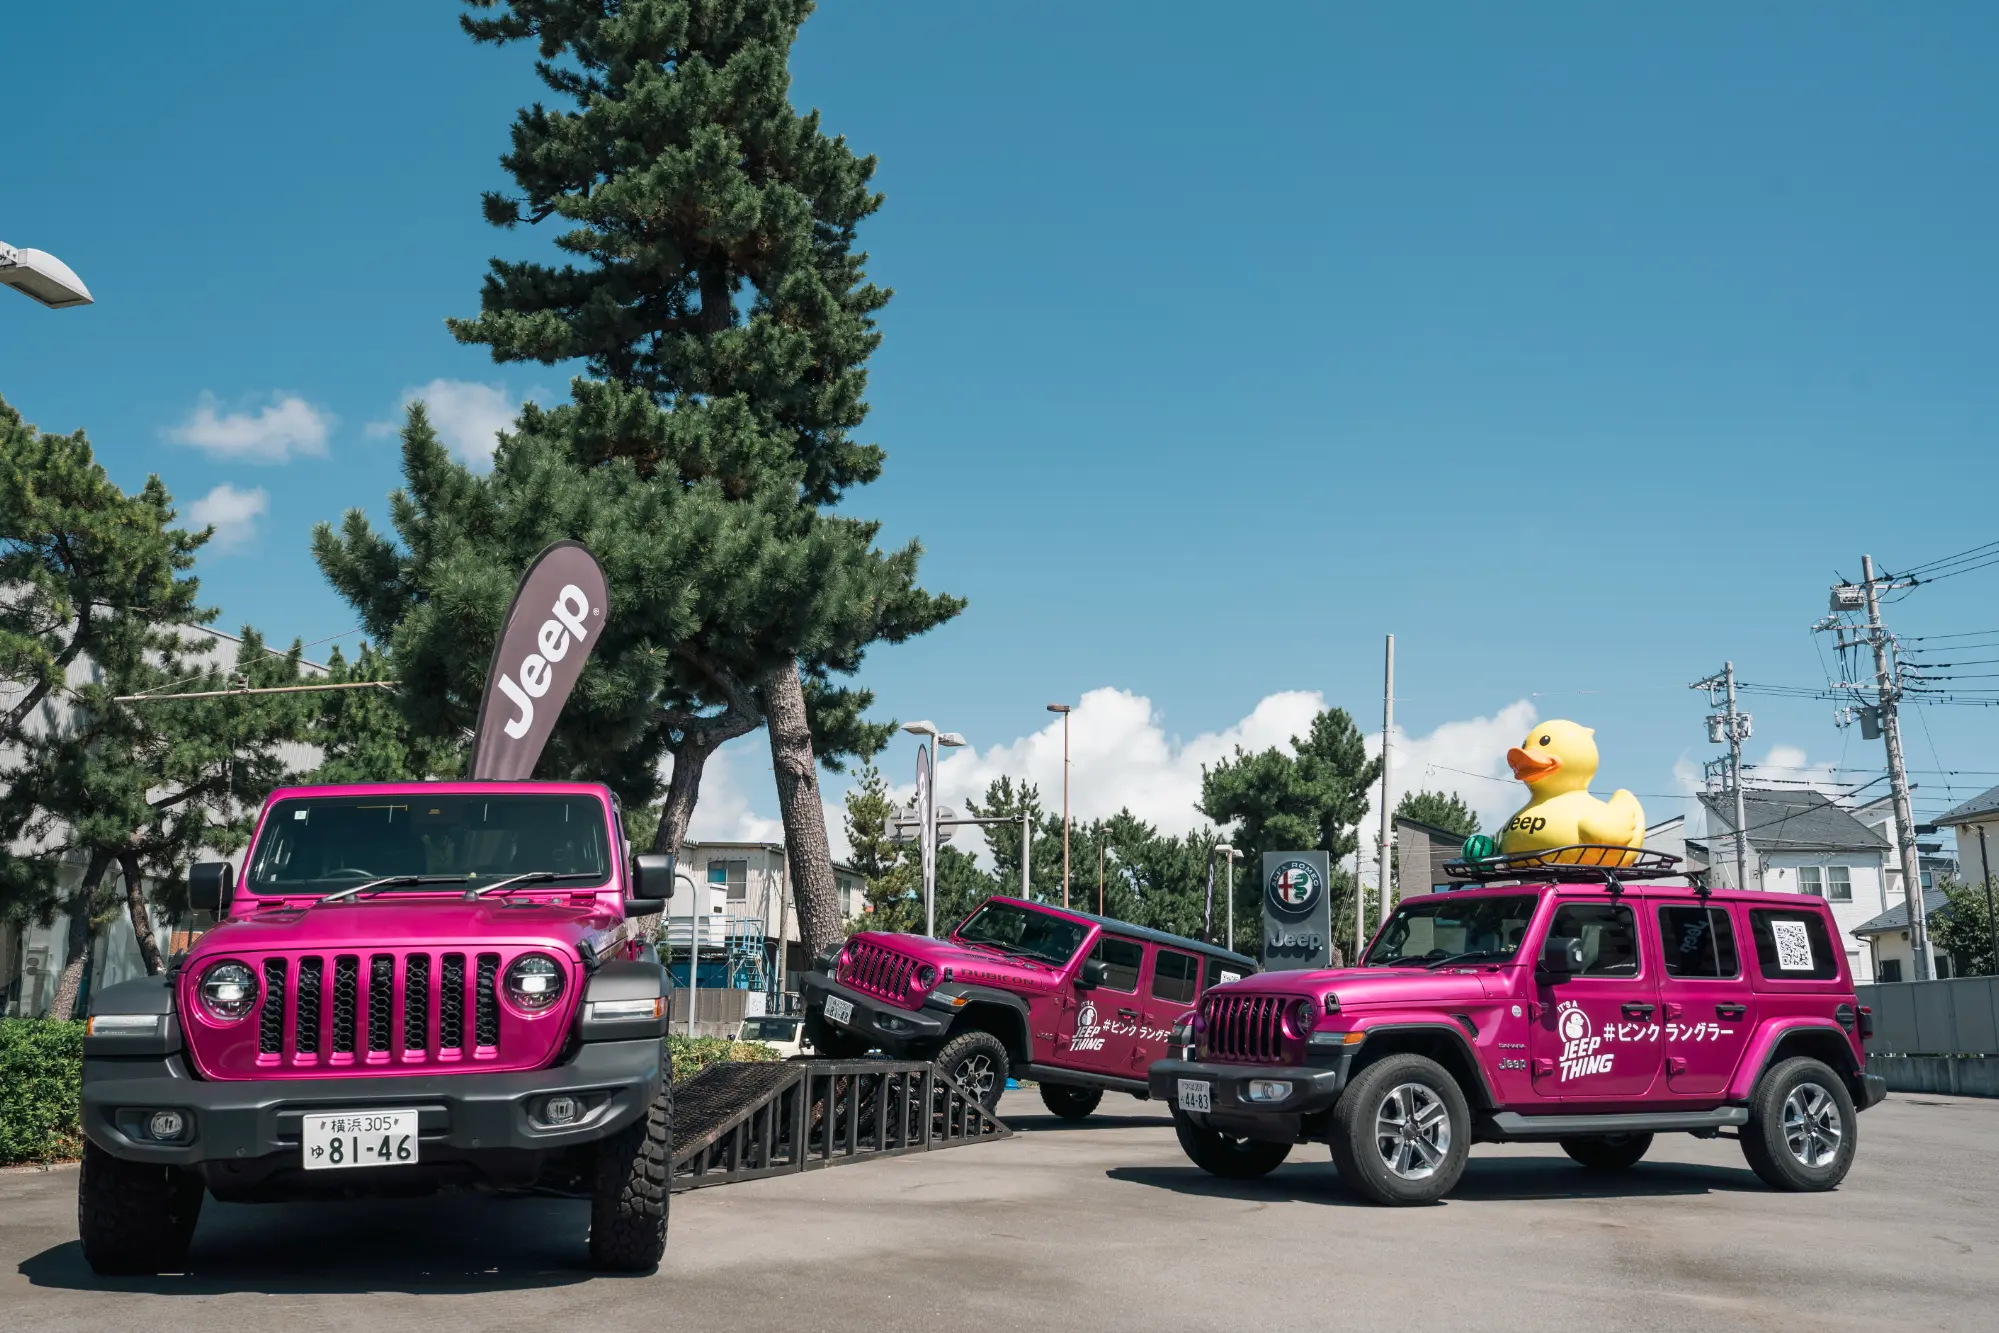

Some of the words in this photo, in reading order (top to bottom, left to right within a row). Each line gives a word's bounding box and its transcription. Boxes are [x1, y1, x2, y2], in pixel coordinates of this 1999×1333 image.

[497, 584, 590, 740] Jeep
[1271, 865, 1288, 887] ALFA
[1291, 862, 1319, 887] ROMEO
[1271, 929, 1322, 950] Jeep
[961, 968, 1035, 984] RUBICON
[1557, 1001, 1571, 1013] IT'S
[1572, 1000, 1578, 1008] A
[1072, 1026, 1101, 1038] JEEP
[1069, 1038, 1106, 1052] THING
[1559, 1036, 1601, 1062] JEEP
[1498, 1057, 1527, 1071] Jeep
[1560, 1054, 1615, 1082] THING
[1186, 1093, 1208, 1109] 44-83
[364, 1116, 392, 1132] 305
[310, 1145, 325, 1159] ゆ
[329, 1134, 412, 1165] 81-46
